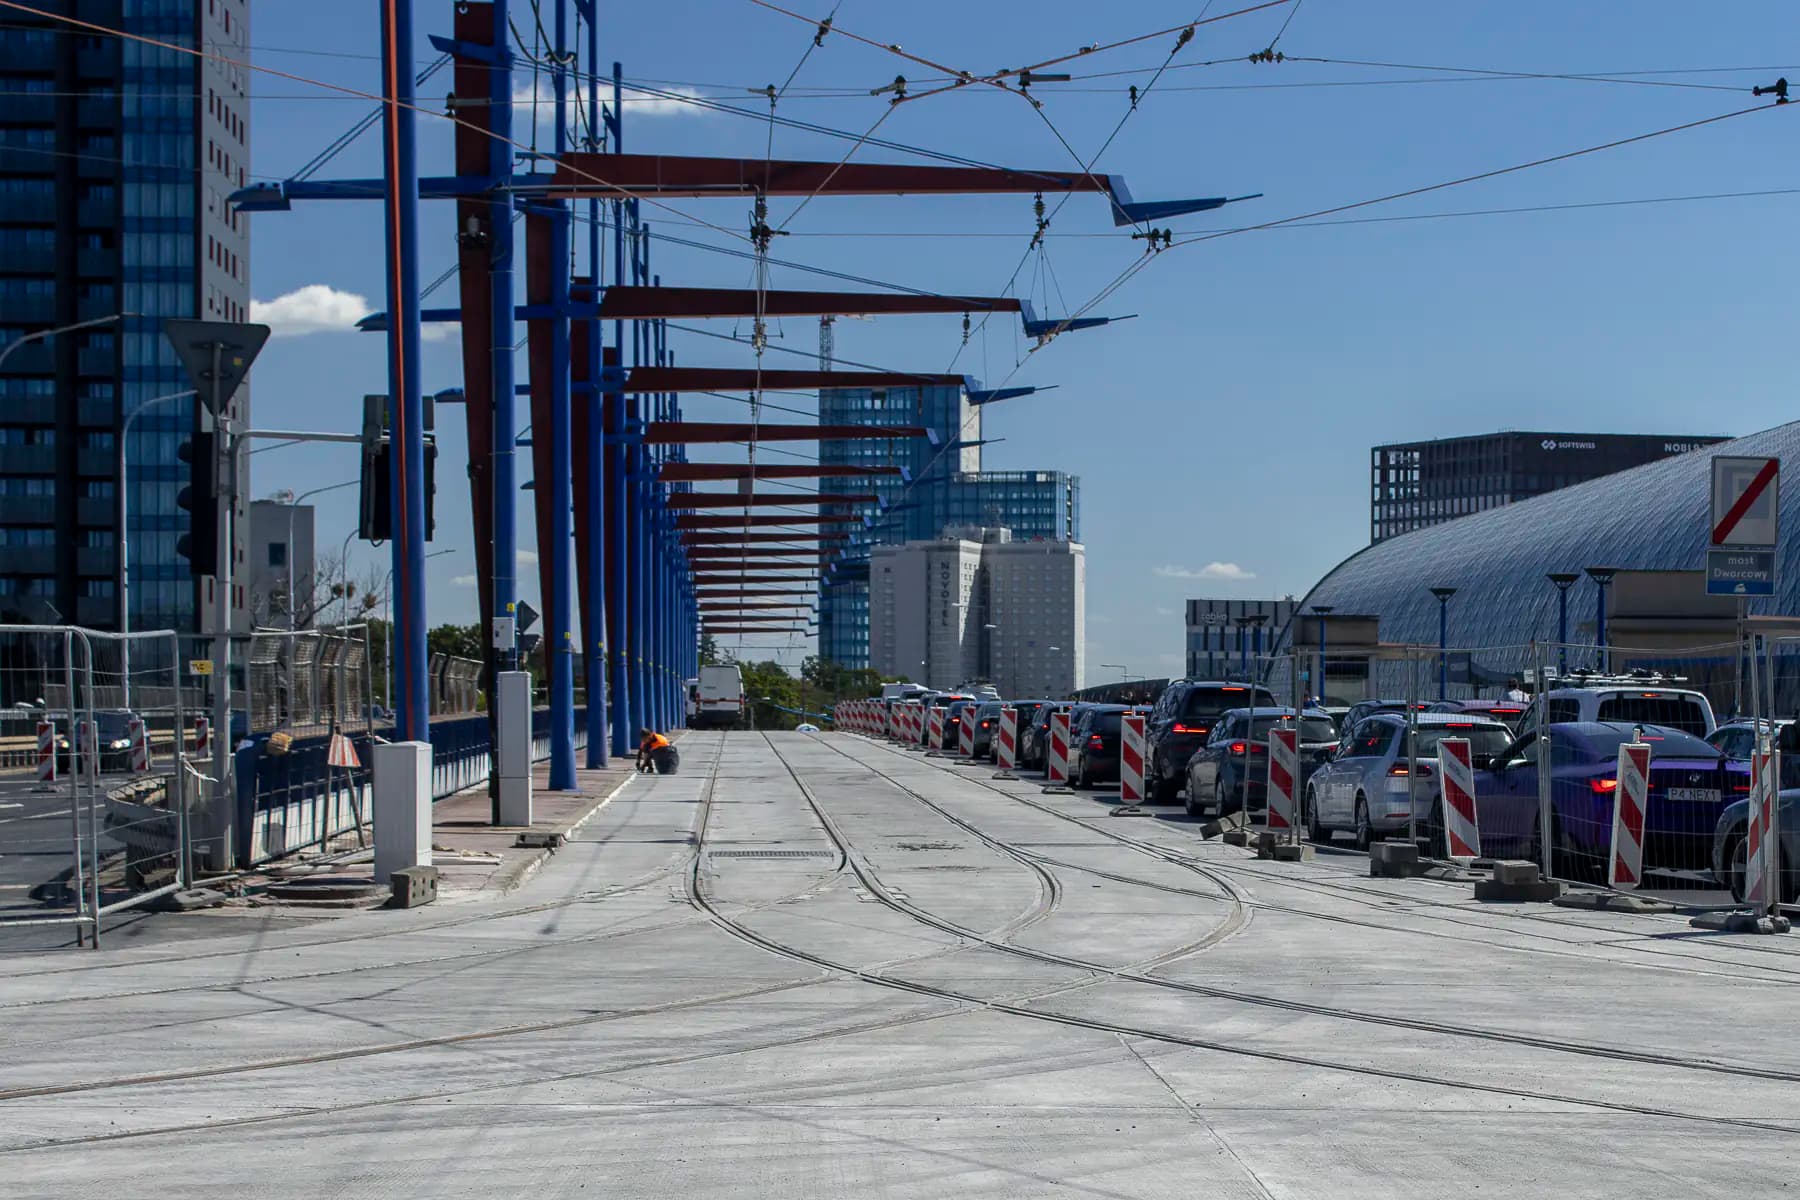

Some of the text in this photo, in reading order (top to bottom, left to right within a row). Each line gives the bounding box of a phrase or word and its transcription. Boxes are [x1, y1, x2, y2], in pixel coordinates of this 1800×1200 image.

[1728, 556, 1754, 565] most
[1713, 567, 1768, 581] Dworcowy
[941, 561, 950, 626] NOVOTEL
[1671, 788, 1684, 799] P4
